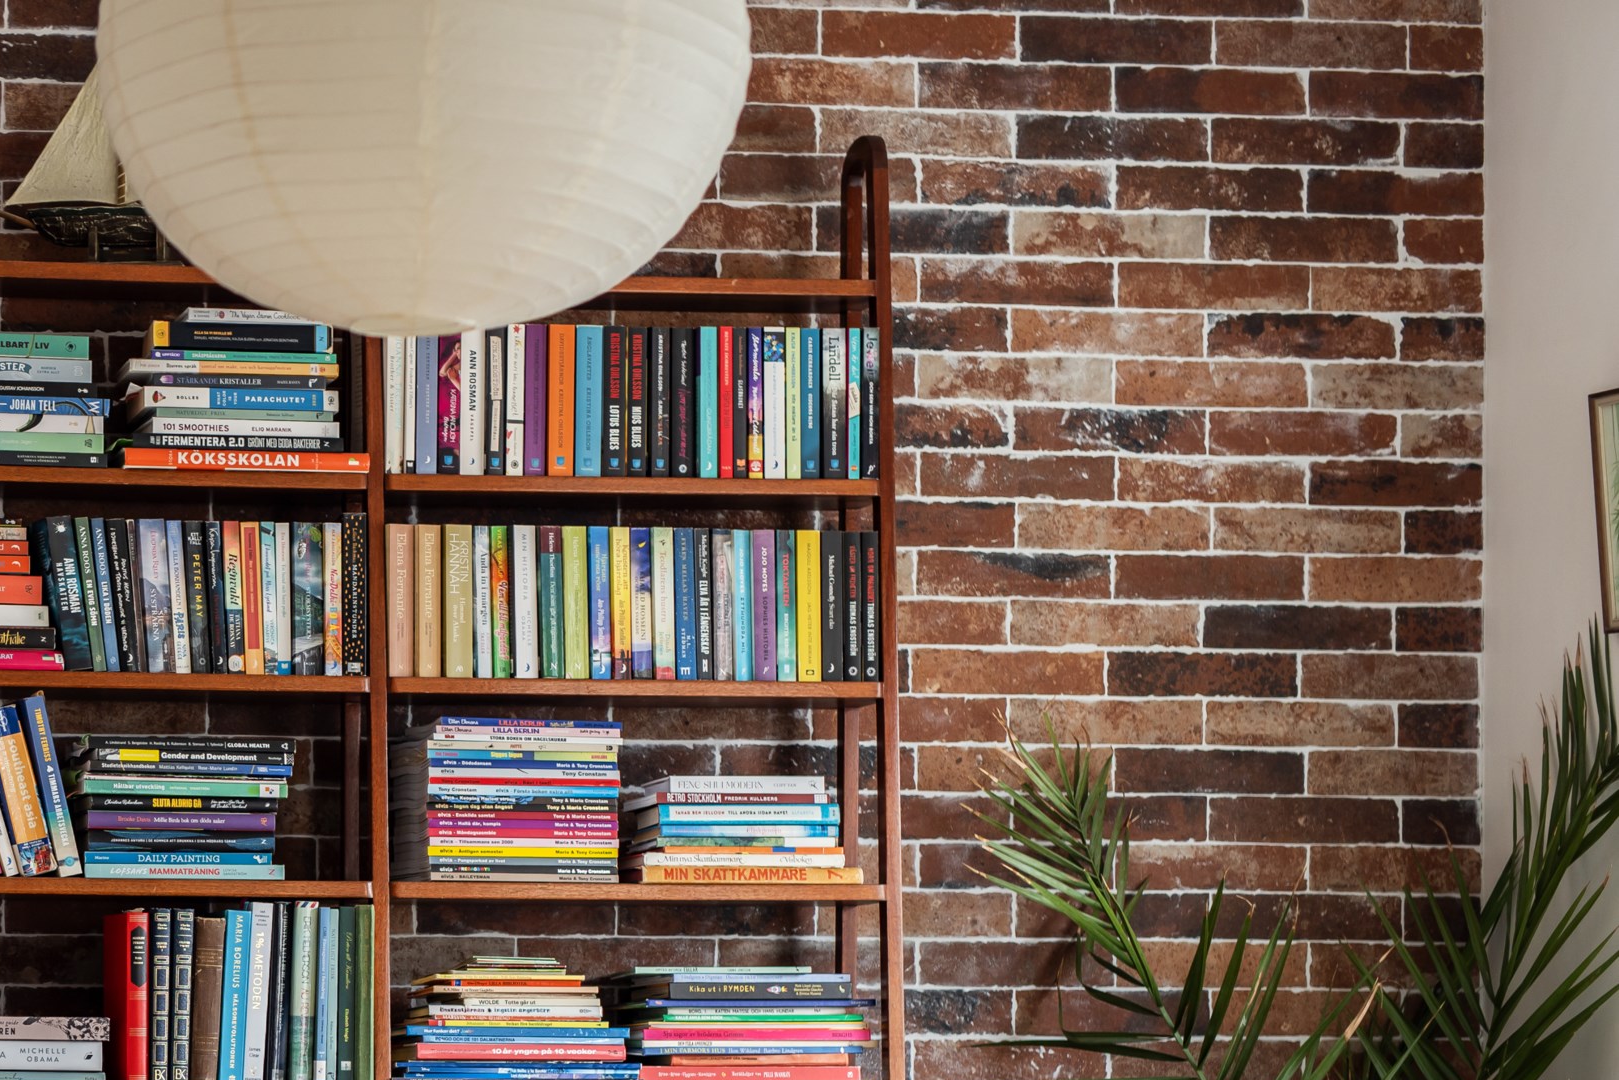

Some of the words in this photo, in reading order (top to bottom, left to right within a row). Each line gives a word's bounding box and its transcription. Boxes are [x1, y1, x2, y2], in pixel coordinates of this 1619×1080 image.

[34, 342, 50, 350] LIV
[610, 333, 620, 365] KRISTINA
[632, 334, 642, 366] KRISTINA
[829, 336, 840, 381] Lindell
[177, 375, 218, 385] STÄRKANDE
[219, 376, 262, 386] KRISTALLER
[610, 367, 620, 399] OHLSSON
[632, 368, 642, 400] OHLSSON
[9, 400, 36, 411] JOHAN
[39, 400, 56, 412] TELL
[245, 396, 305, 404] PARACHUTE?
[609, 405, 620, 428] LOTUS
[631, 406, 642, 424] MIOS
[163, 422, 176, 430] 101
[179, 423, 230, 432] SMOOTHIES
[631, 426, 641, 448] BLUES
[163, 436, 226, 448] FERMENTERA
[229, 438, 245, 448] 2.0
[248, 438, 265, 448] GRÖNT
[266, 439, 278, 448] MED
[278, 440, 293, 449] GODA
[293, 440, 321, 450] BAKTERIER
[609, 429, 620, 451] BLUES
[178, 450, 300, 467] KÖKSSKOLAN
[79, 526, 88, 550] ANNA
[95, 528, 104, 551] ANNA
[396, 533, 407, 565] Elena
[423, 533, 435, 565] Elena
[63, 558, 77, 576] ANN
[81, 551, 91, 575] ROOS
[98, 552, 107, 576] ROOS
[193, 554, 202, 590] PETER
[449, 533, 460, 594] HANNAH
[459, 540, 470, 582] KRISTIN
[55, 563, 68, 611] HAVSKATTEN
[85, 580, 93, 589] EN
[101, 582, 110, 597] LIKA
[229, 554, 240, 605] Regnvakt
[699, 580, 709, 596] ELVA
[782, 554, 790, 607] TOKTANTEN
[67, 577, 82, 614] ROSMAN
[87, 590, 96, 606] EVIG
[396, 568, 407, 619] Ferrante
[424, 568, 435, 619] Ferrante
[700, 597, 711, 606] ÅR
[89, 608, 99, 627] SÖMN
[103, 603, 113, 625] DÖDEN
[195, 596, 204, 618] MAY
[849, 602, 857, 625] THOMAS
[867, 604, 875, 627] THOMAS
[700, 612, 711, 655] FÅNGENSKAP
[849, 626, 859, 656] ENGSTRÖM
[867, 630, 877, 661] ENGSTRÖM
[34, 708, 45, 735] TIMOTHY
[40, 736, 52, 763] FERRISS
[161, 752, 189, 760] Gender
[191, 752, 205, 761] and
[207, 753, 257, 763] Development
[7, 739, 32, 802] southeast
[23, 802, 37, 829] asia
[47, 774, 60, 804] TIMMARS
[153, 798, 171, 808] SLUTA
[172, 798, 193, 808] ALDRIG
[193, 798, 202, 809] GÅ
[667, 793, 686, 803] RETRO
[687, 793, 722, 803] STOCKHOLM
[53, 804, 70, 847] ARBETSVECKA
[138, 854, 168, 862] DAILY
[171, 855, 220, 863] PAINTING
[149, 866, 220, 876] MAMMATRÄNING
[663, 868, 689, 881] MIN
[693, 868, 807, 882] SKATTKAMMARE
[235, 914, 244, 944] MARIA
[232, 947, 242, 989] BORELIUS
[252, 932, 265, 1011] 1%-METODEN
[723, 985, 755, 993] RYMDEN
[229, 994, 239, 1069] HÄLSOREVOLUTIONEN
[502, 1046, 512, 1054] år
[514, 1048, 539, 1056] yngre
[541, 1046, 553, 1056] på
